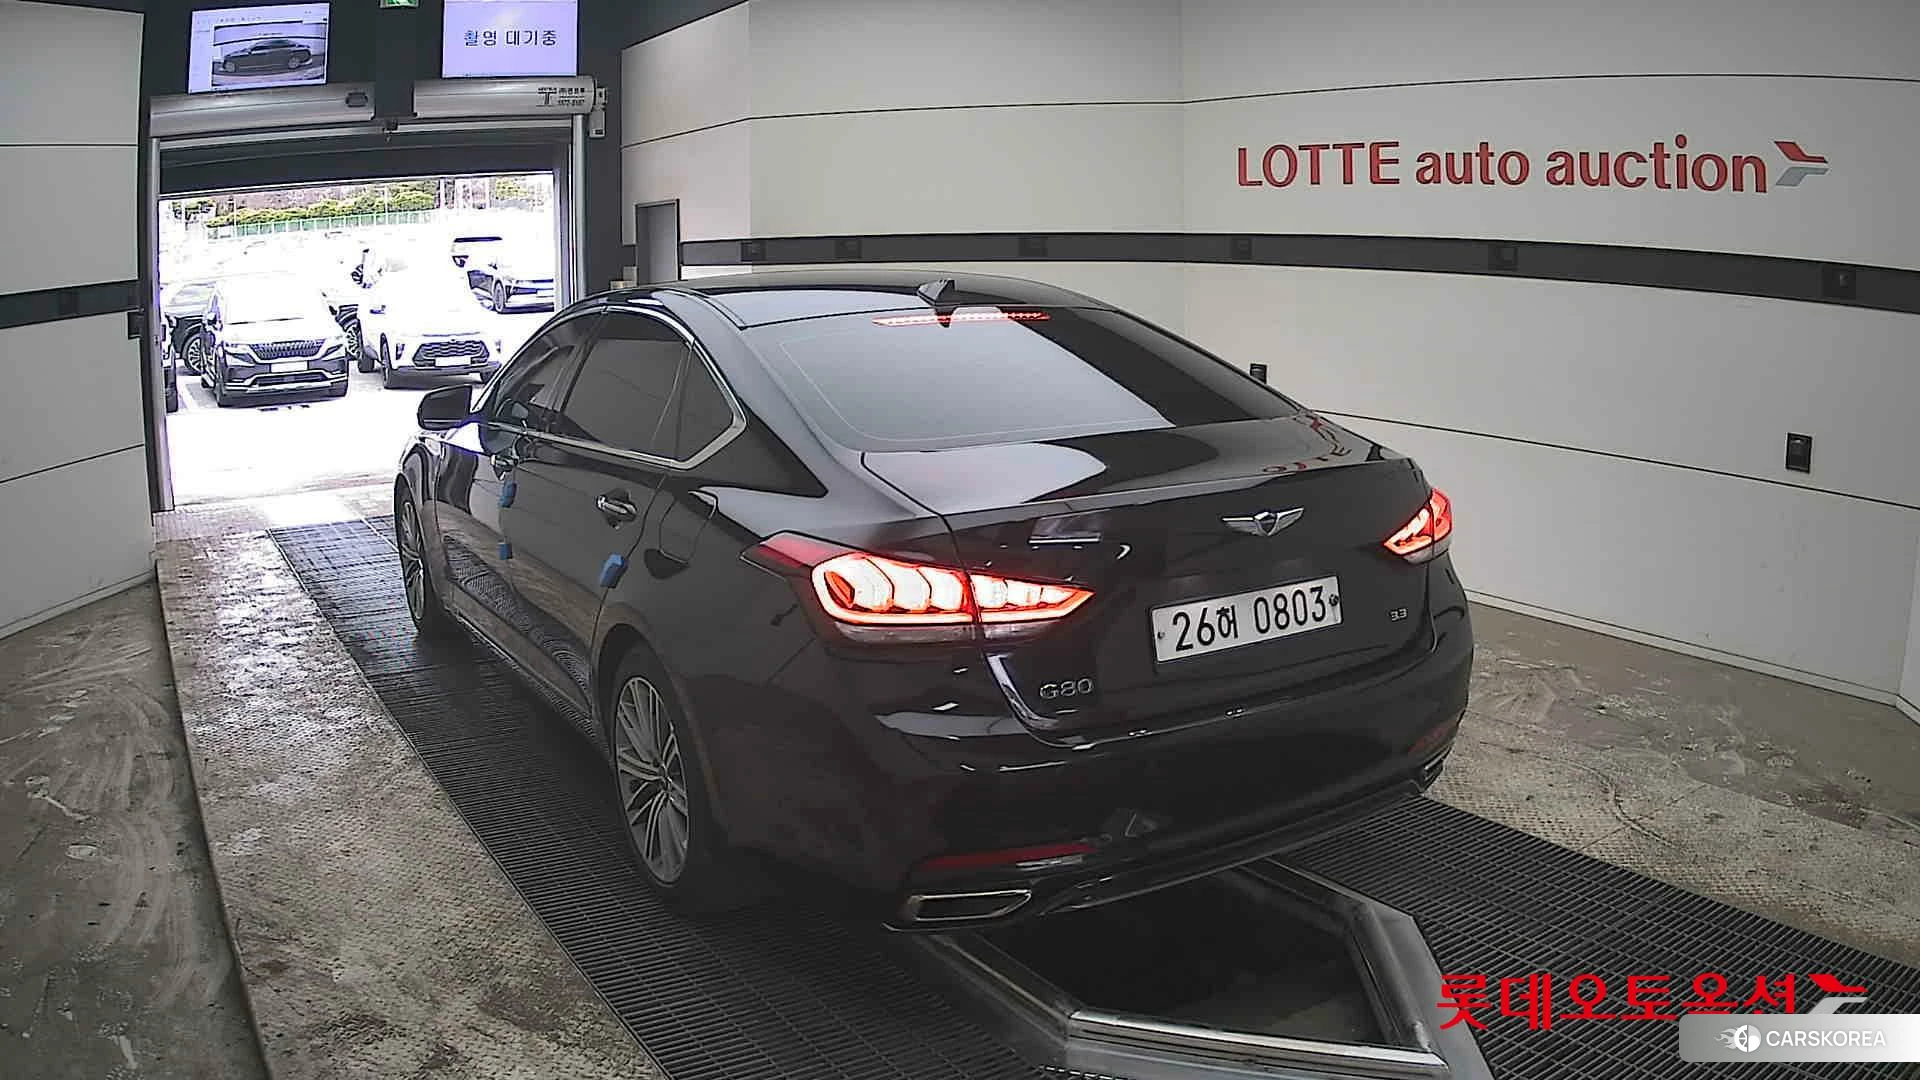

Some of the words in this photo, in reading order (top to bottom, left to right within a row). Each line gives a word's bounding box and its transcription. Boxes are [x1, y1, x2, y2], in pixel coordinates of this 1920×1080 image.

[506, 30, 557, 46] 대기중
[1238, 141, 1400, 188] LOTTE
[1415, 142, 1530, 186] auto
[1546, 134, 1767, 193] auction
[1173, 605, 1239, 652] 26허
[1253, 585, 1327, 634] 0803
[1040, 678, 1093, 699] G80
